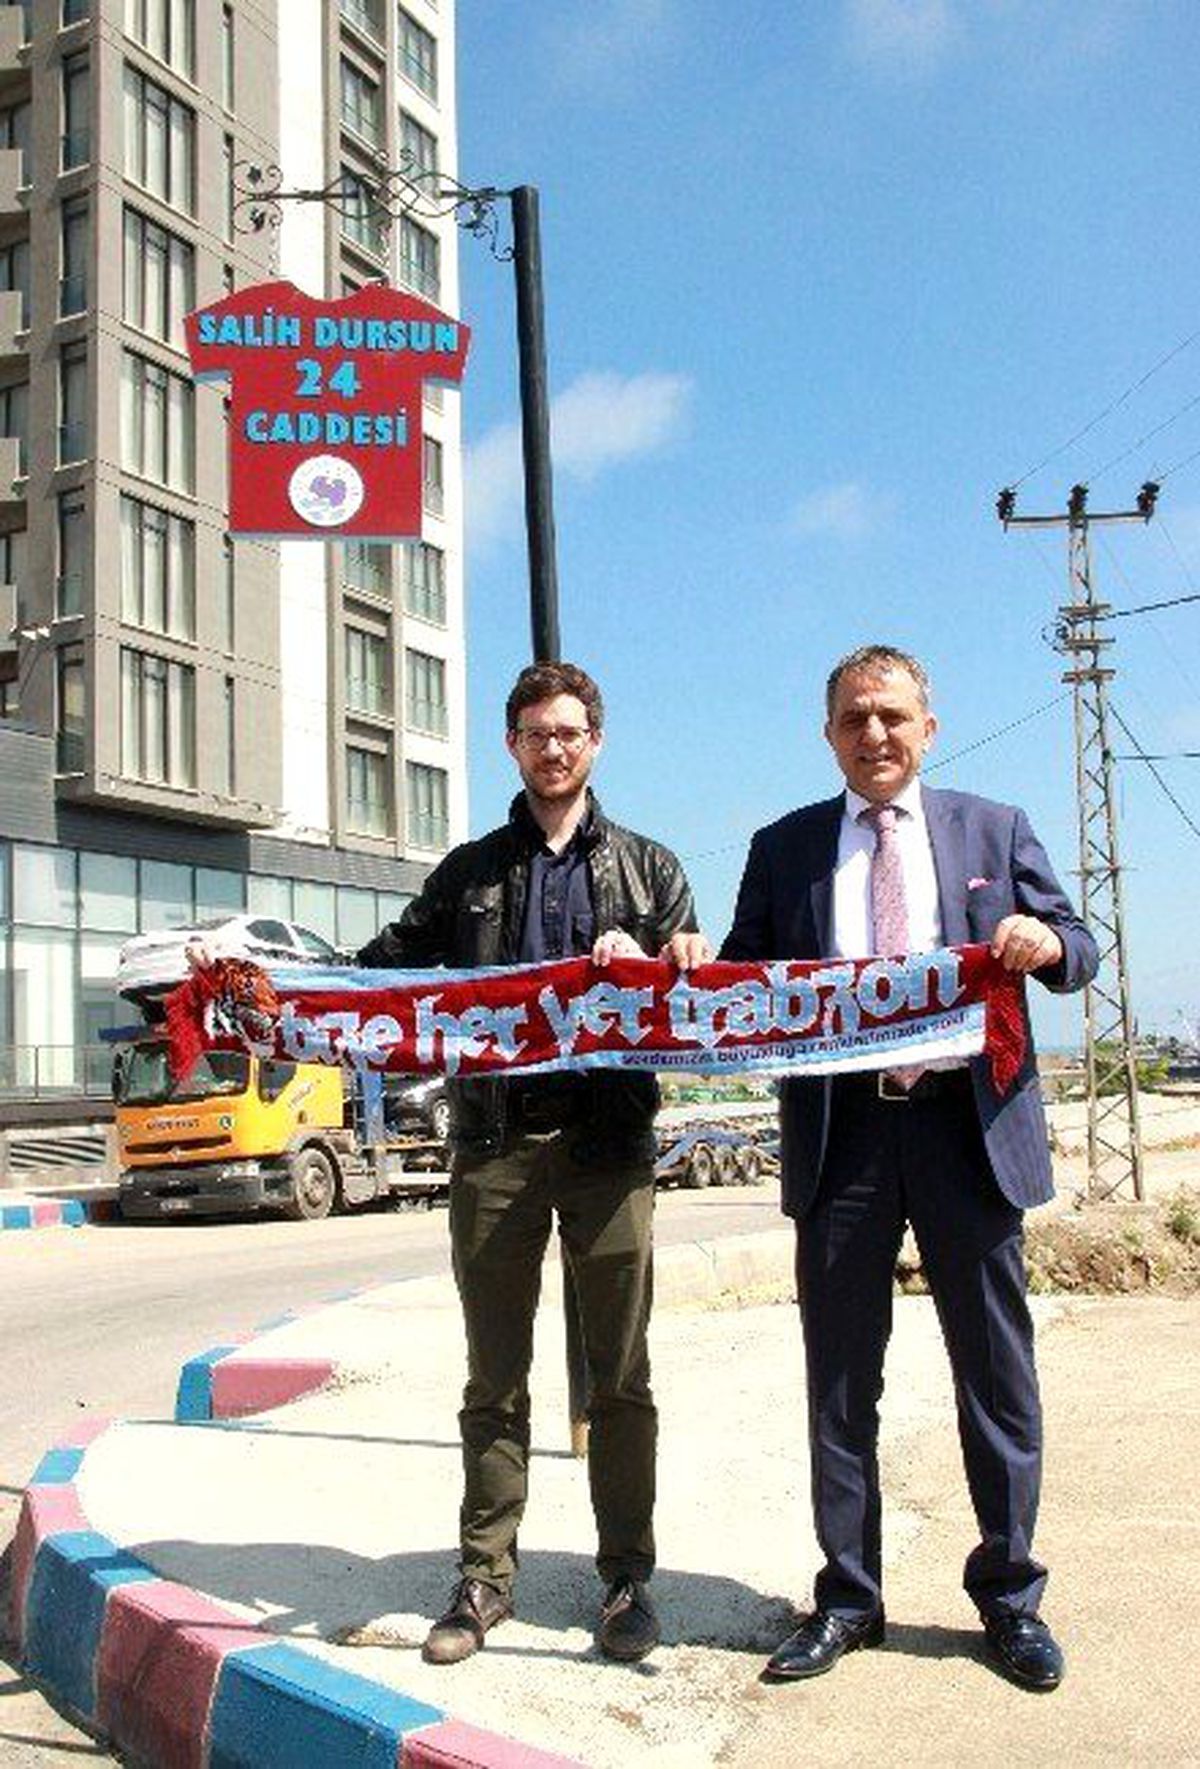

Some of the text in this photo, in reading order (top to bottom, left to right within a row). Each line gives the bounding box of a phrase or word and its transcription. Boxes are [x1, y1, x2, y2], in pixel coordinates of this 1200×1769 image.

[200, 306, 459, 352] SALİH DURSUN
[294, 357, 362, 400] 24
[244, 407, 408, 447] CADDESİ
[413, 993, 529, 1078] her
[538, 981, 655, 1056] yer
[663, 947, 967, 1050] trabzon
